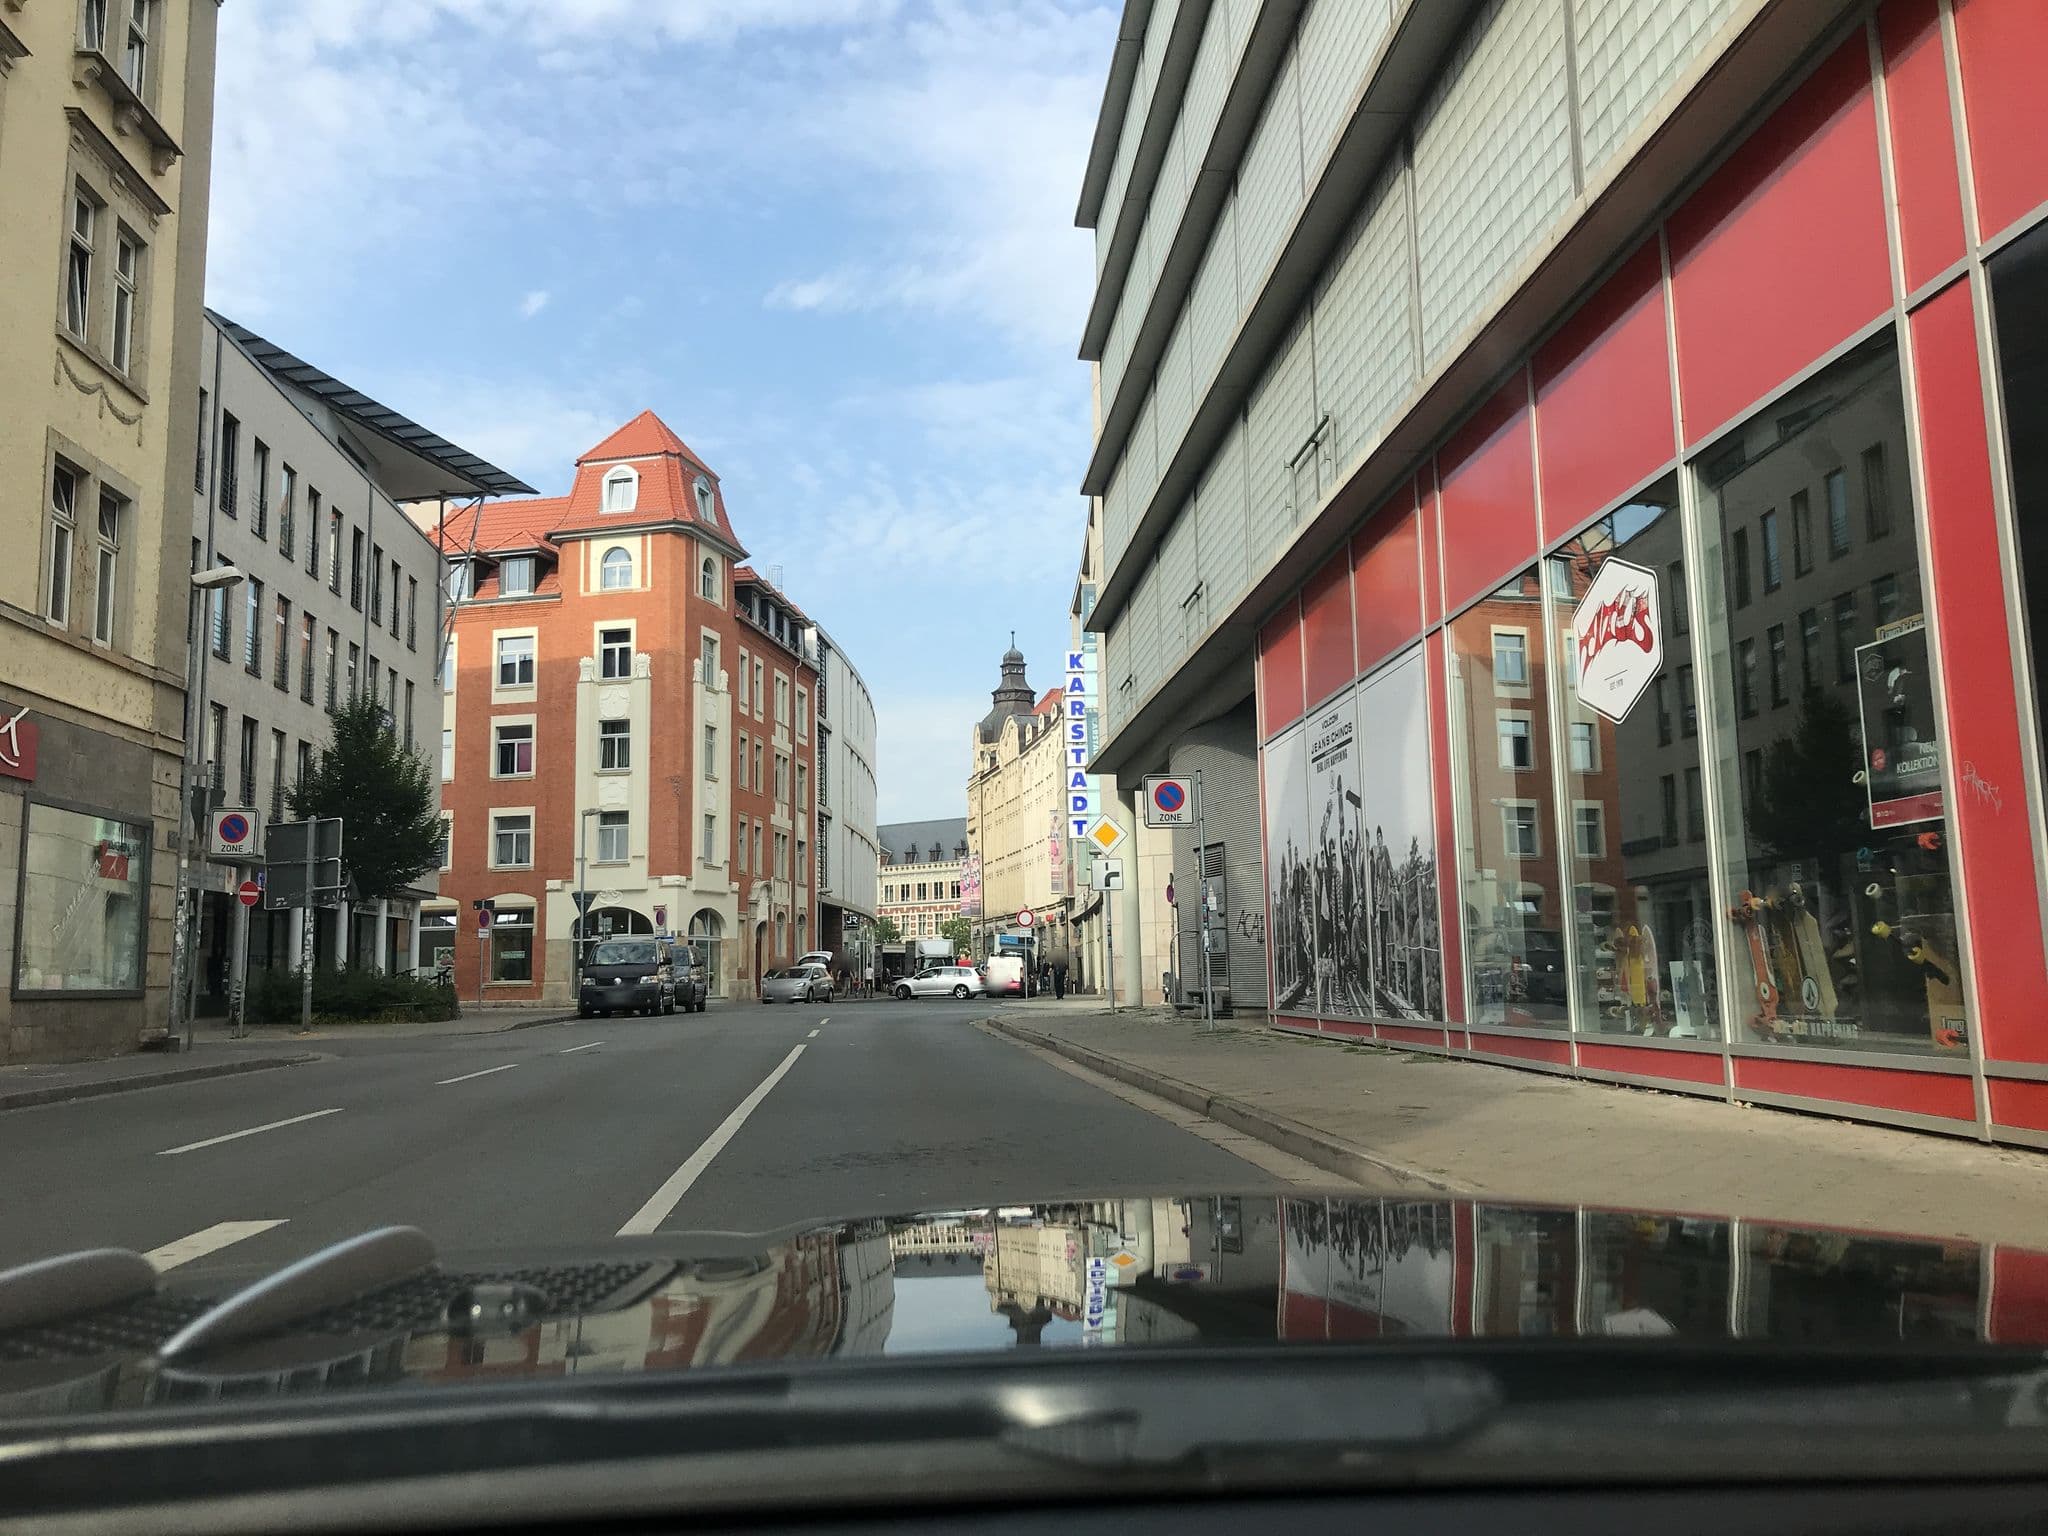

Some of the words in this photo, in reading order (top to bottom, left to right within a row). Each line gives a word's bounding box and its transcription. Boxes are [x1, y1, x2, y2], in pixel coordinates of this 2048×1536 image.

[1069, 653, 1087, 836] KARSTADT
[1159, 813, 1183, 822] ZONE
[220, 844, 244, 853] ZONE
